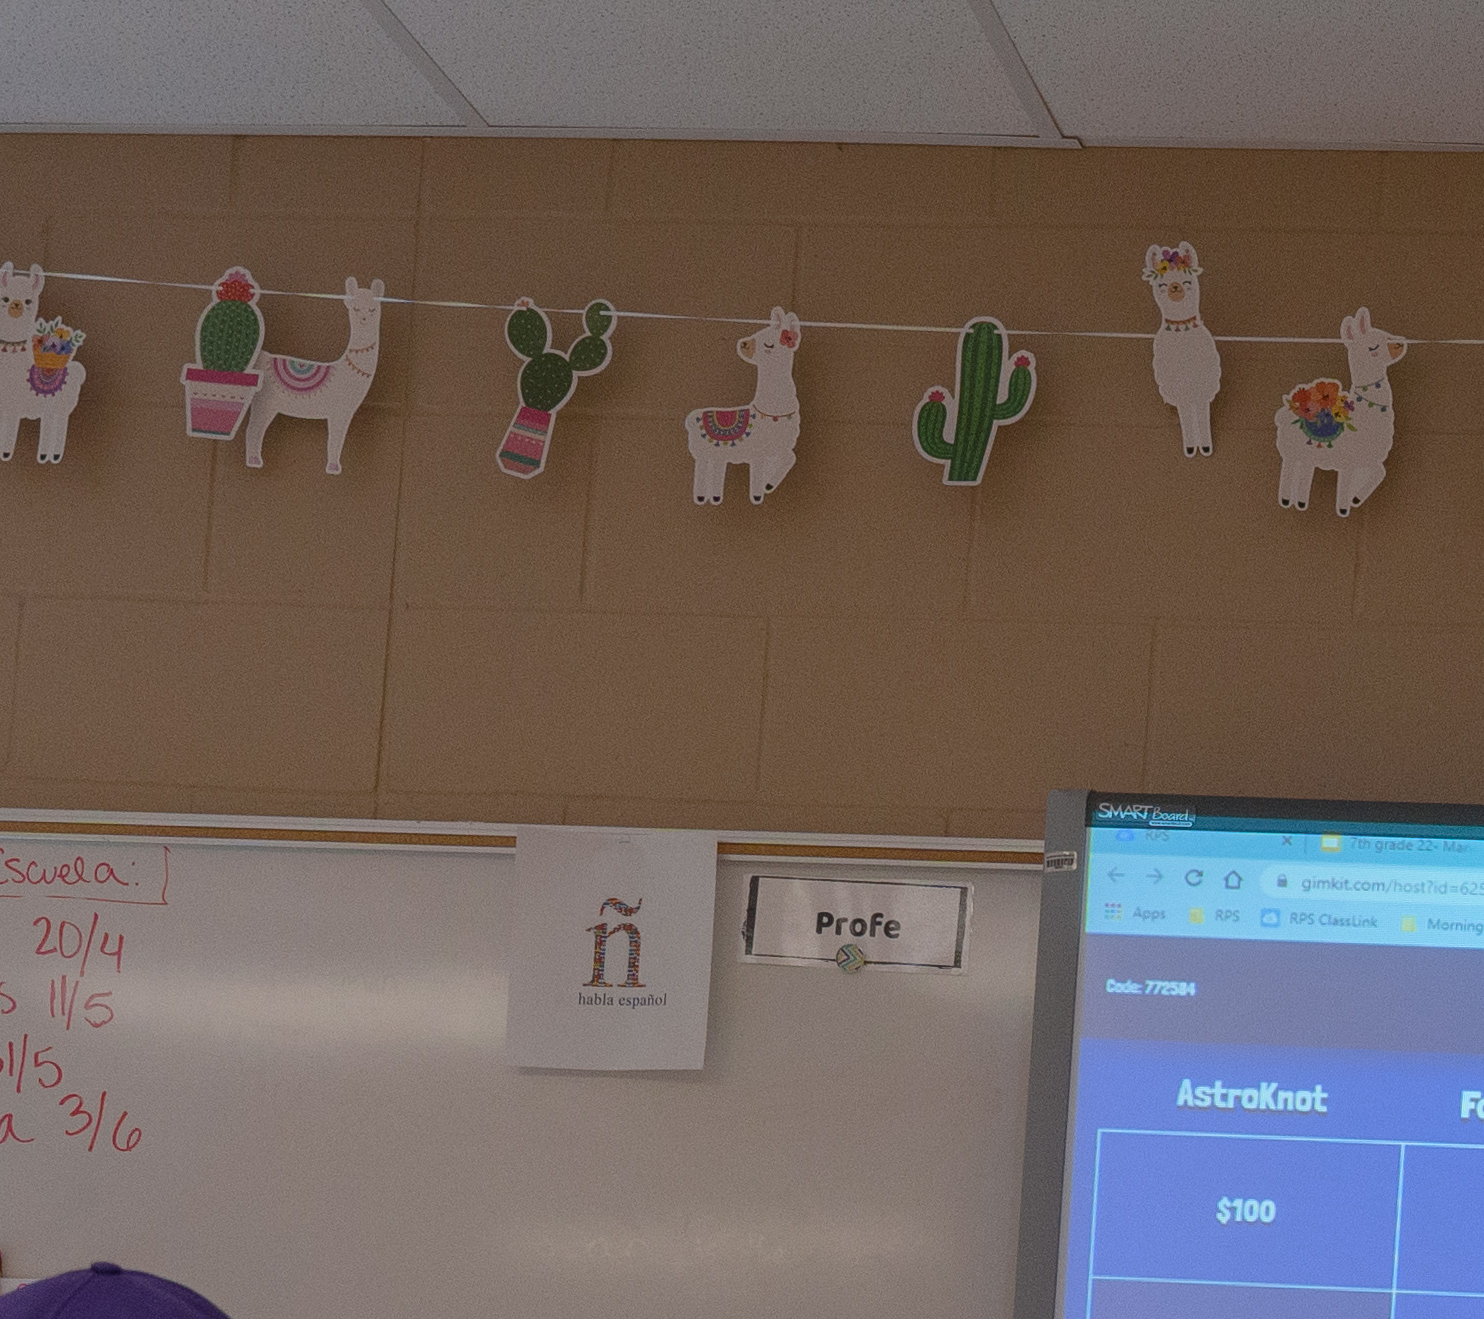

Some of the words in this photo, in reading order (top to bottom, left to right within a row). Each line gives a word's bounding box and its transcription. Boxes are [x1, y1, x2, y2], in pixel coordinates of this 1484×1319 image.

[1098, 802, 1153, 819] SMART
[1152, 806, 1189, 821] Board
[1375, 839, 1413, 853] grade
[816, 911, 901, 940] Profe
[1133, 907, 1166, 922] Apps
[1216, 909, 1240, 922] RPS
[1290, 913, 1314, 926] RPS
[1427, 917, 1483, 934] Morning
[33, 912, 125, 976] 20/4
[582, 897, 646, 988] ñ
[49, 974, 115, 1030] 11/5
[577, 991, 614, 1007] habla
[619, 992, 667, 1010] español
[1176, 1078, 1328, 1113] AstroKnot
[59, 1090, 143, 1152] 3/6
[1216, 1195, 1276, 1227] $100
